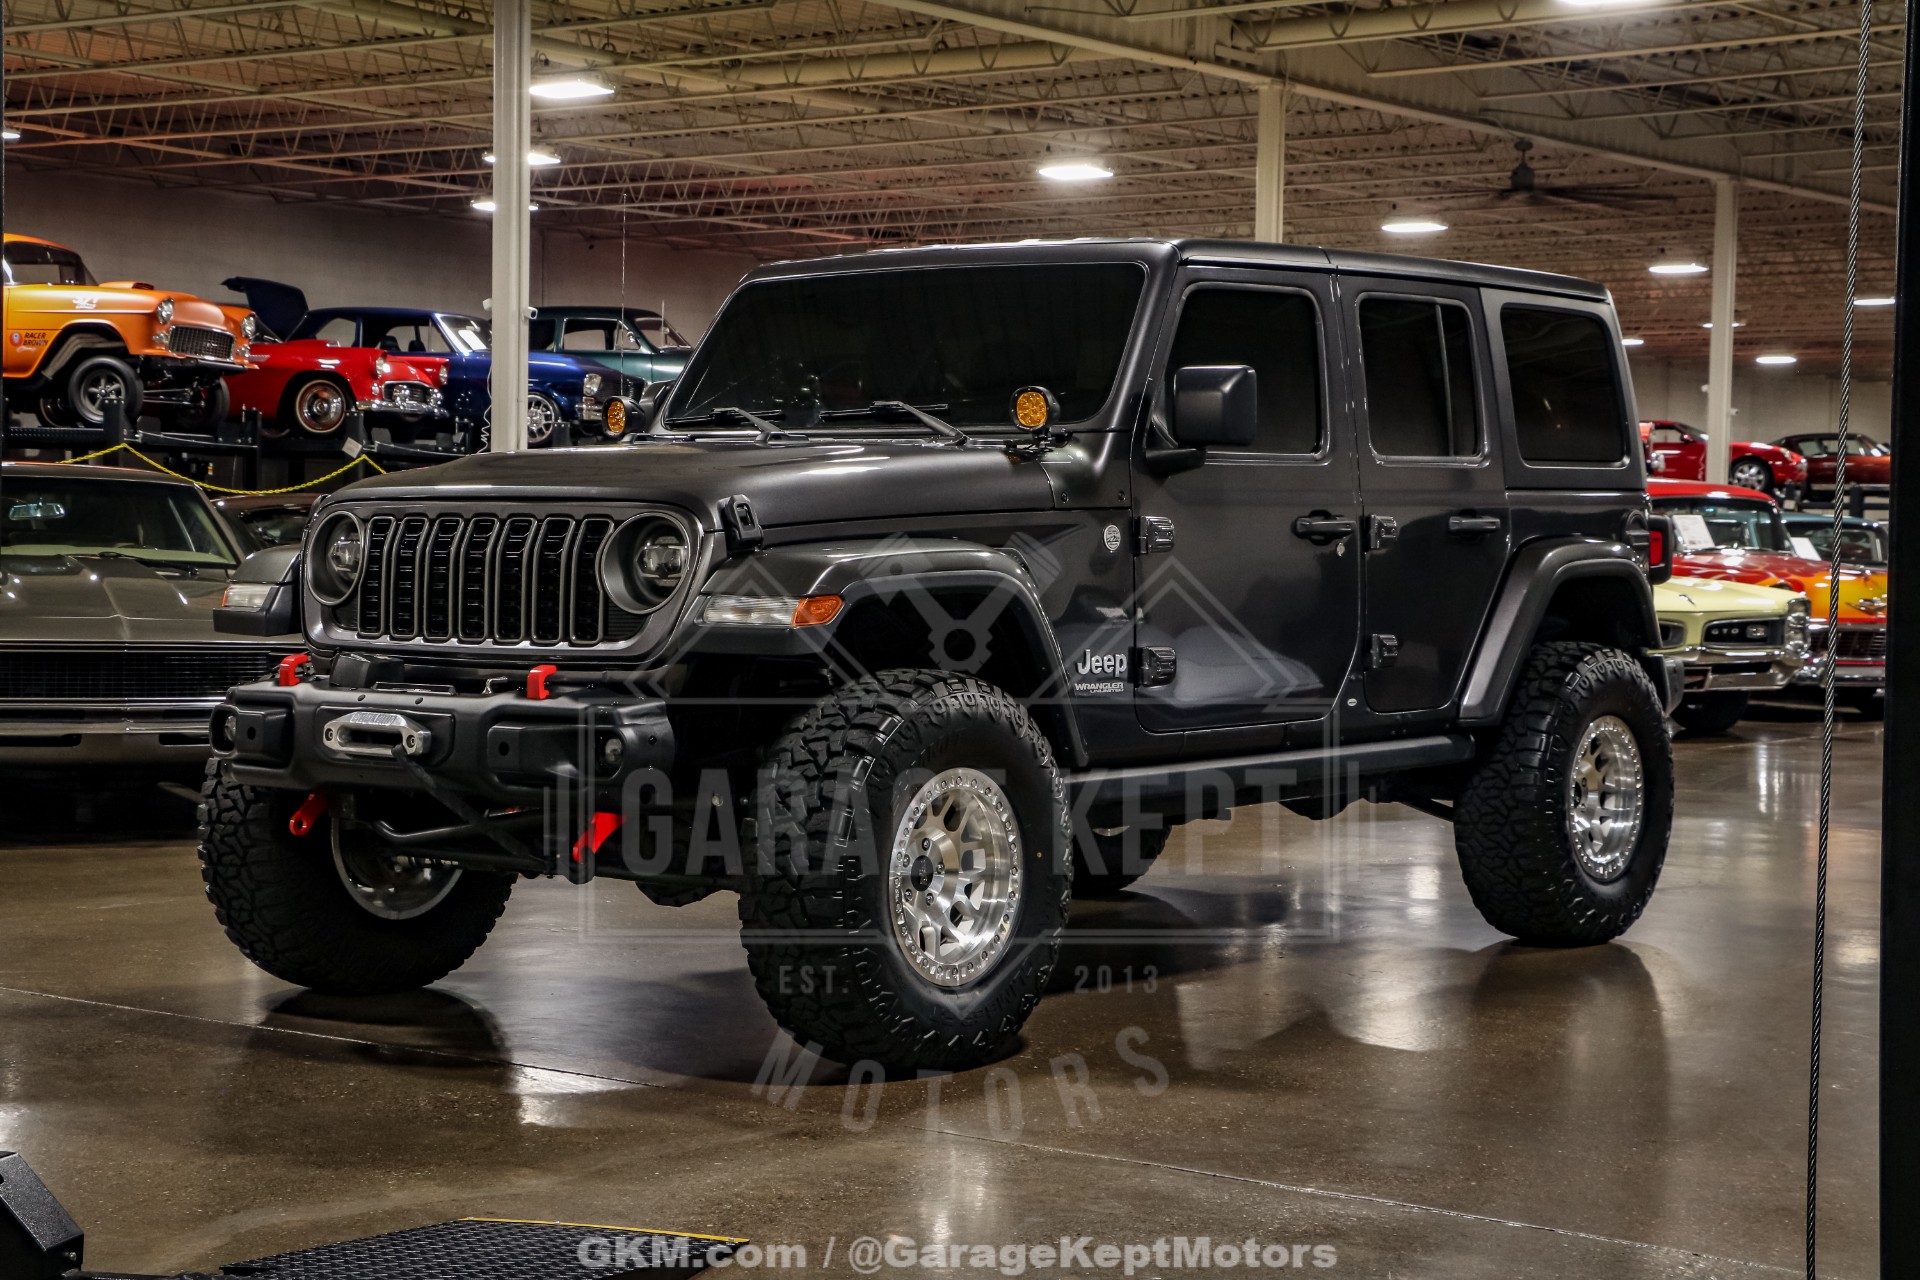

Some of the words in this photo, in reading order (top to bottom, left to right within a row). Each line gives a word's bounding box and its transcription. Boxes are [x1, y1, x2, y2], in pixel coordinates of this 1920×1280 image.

[1711, 627, 1740, 635] GTO
[1076, 649, 1127, 678] Jeep
[1074, 682, 1124, 691] WRANGLER
